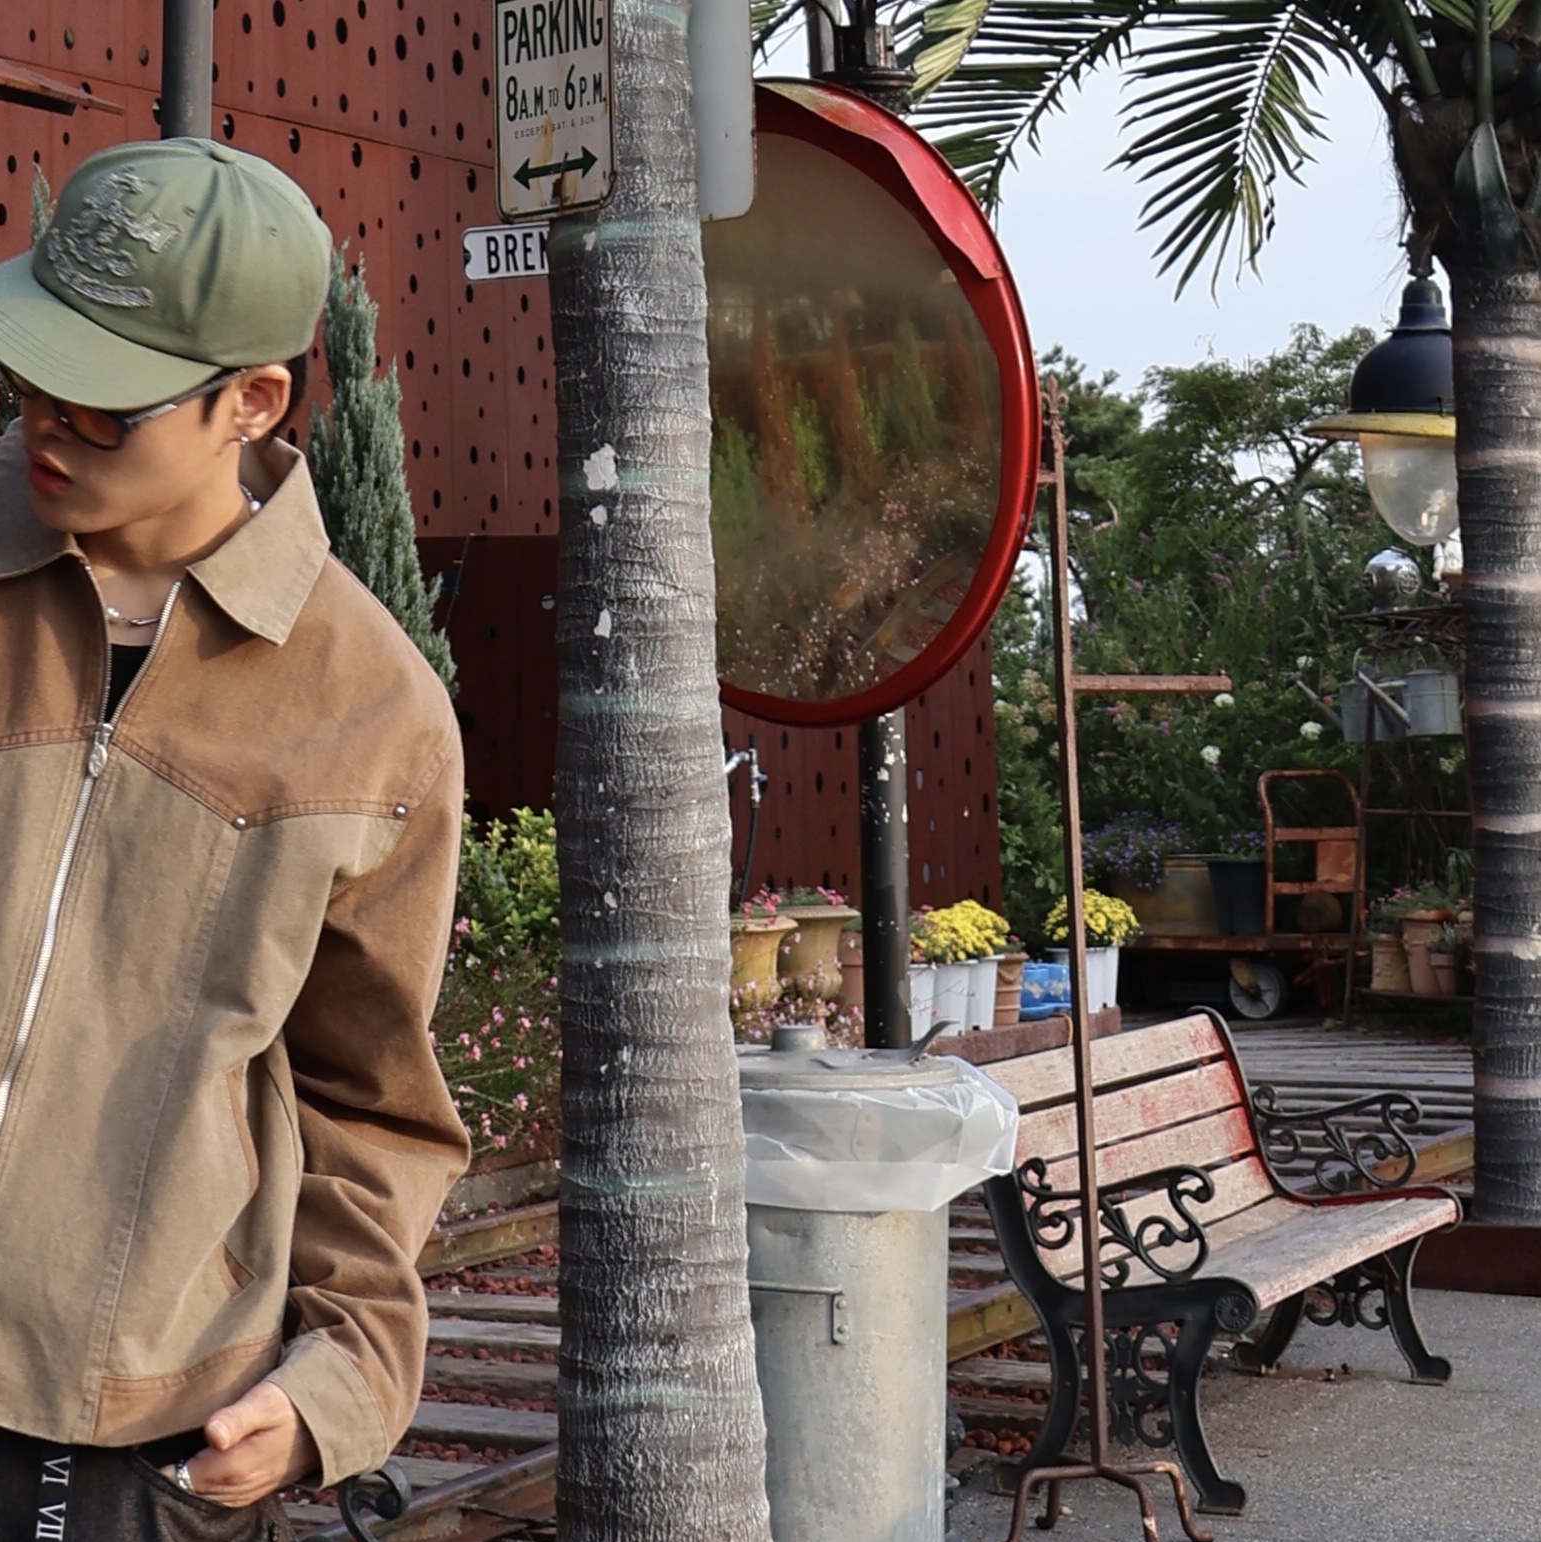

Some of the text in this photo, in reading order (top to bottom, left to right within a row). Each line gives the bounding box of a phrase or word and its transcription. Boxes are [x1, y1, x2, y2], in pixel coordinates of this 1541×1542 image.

[504, 0, 604, 66] PARKING
[548, 87, 560, 108] TO
[41, 1455, 71, 1487] VI
[35, 1501, 66, 1542] VII
